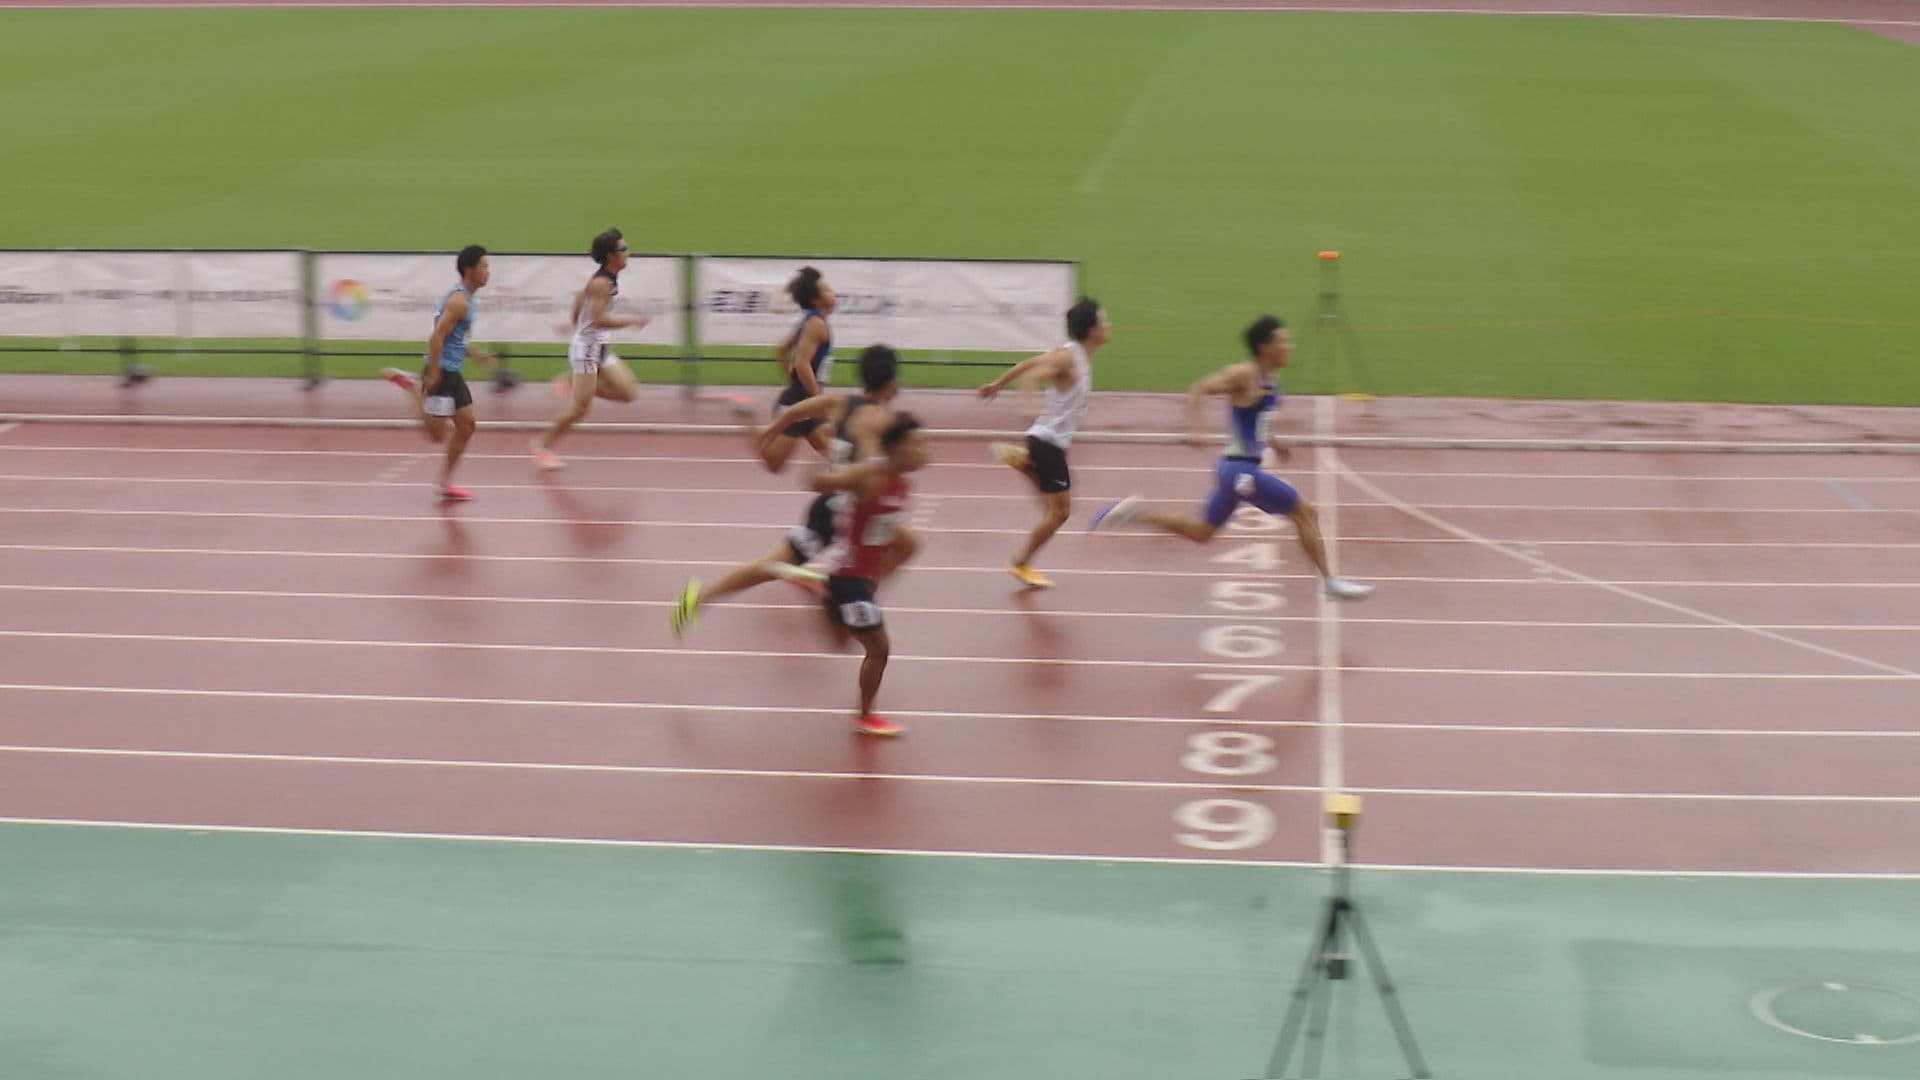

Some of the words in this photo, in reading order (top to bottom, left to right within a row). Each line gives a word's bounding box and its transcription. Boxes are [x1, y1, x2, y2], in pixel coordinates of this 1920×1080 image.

[1209, 542, 1288, 571] 4
[1208, 580, 1286, 611] 5
[1200, 624, 1286, 658] 6
[1195, 672, 1284, 713] 7
[1181, 730, 1279, 776] 8
[1173, 797, 1276, 851] 9
